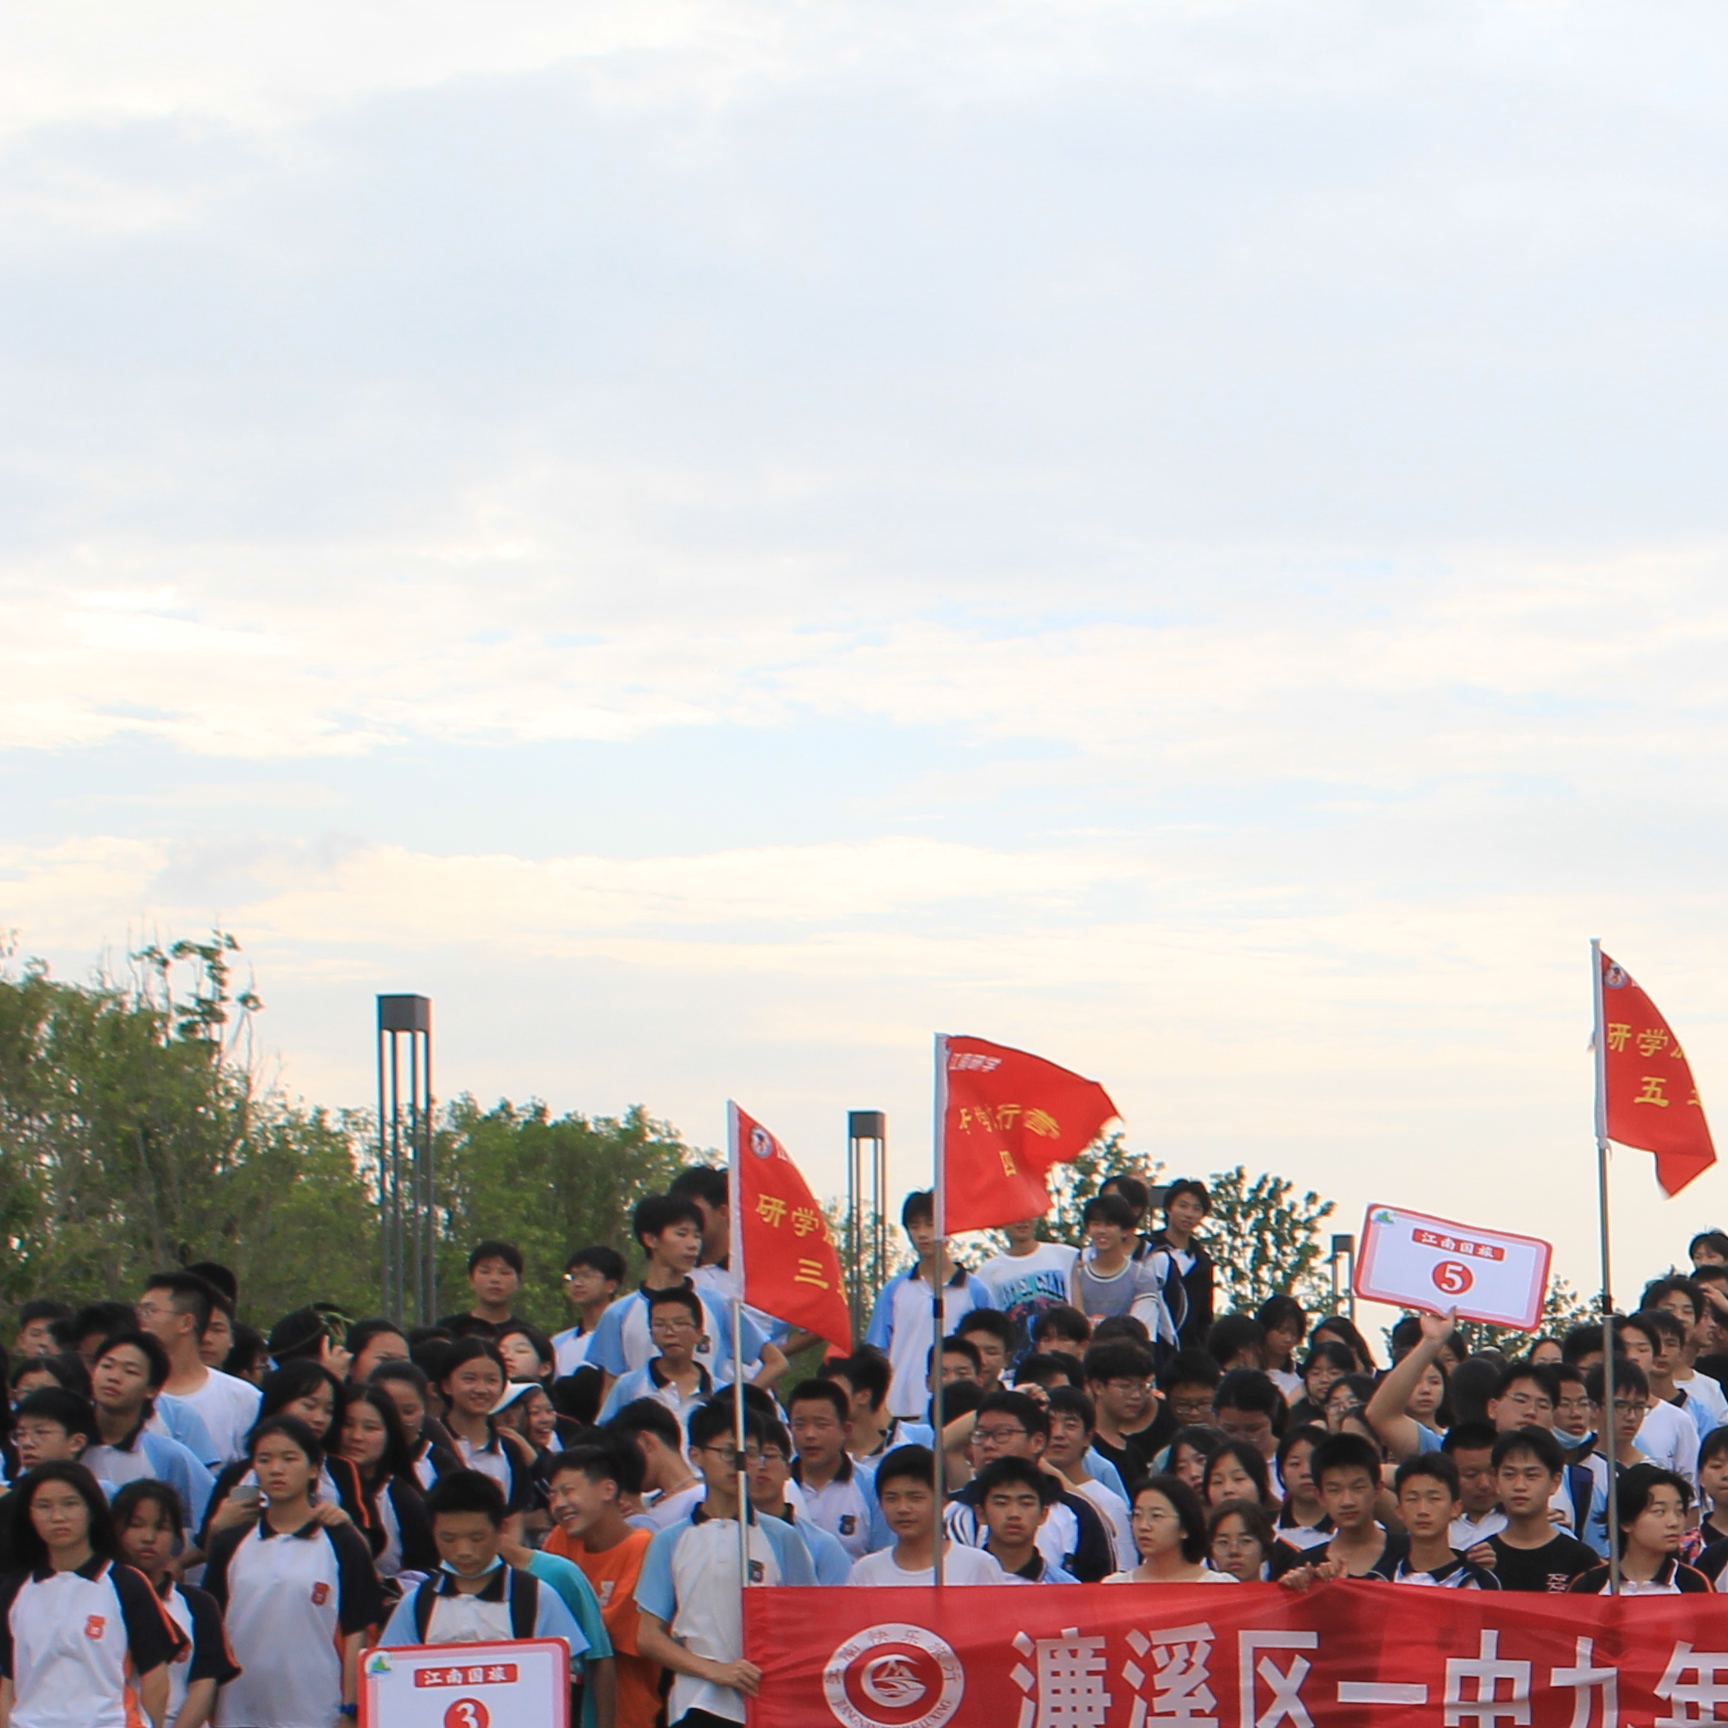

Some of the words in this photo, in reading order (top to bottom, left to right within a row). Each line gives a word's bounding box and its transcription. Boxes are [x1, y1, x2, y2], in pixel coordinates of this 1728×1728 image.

[1421, 1231, 1495, 1259] 江南国旅
[1440, 1263, 1465, 1291] 5
[423, 1666, 509, 1685] 江南国旅
